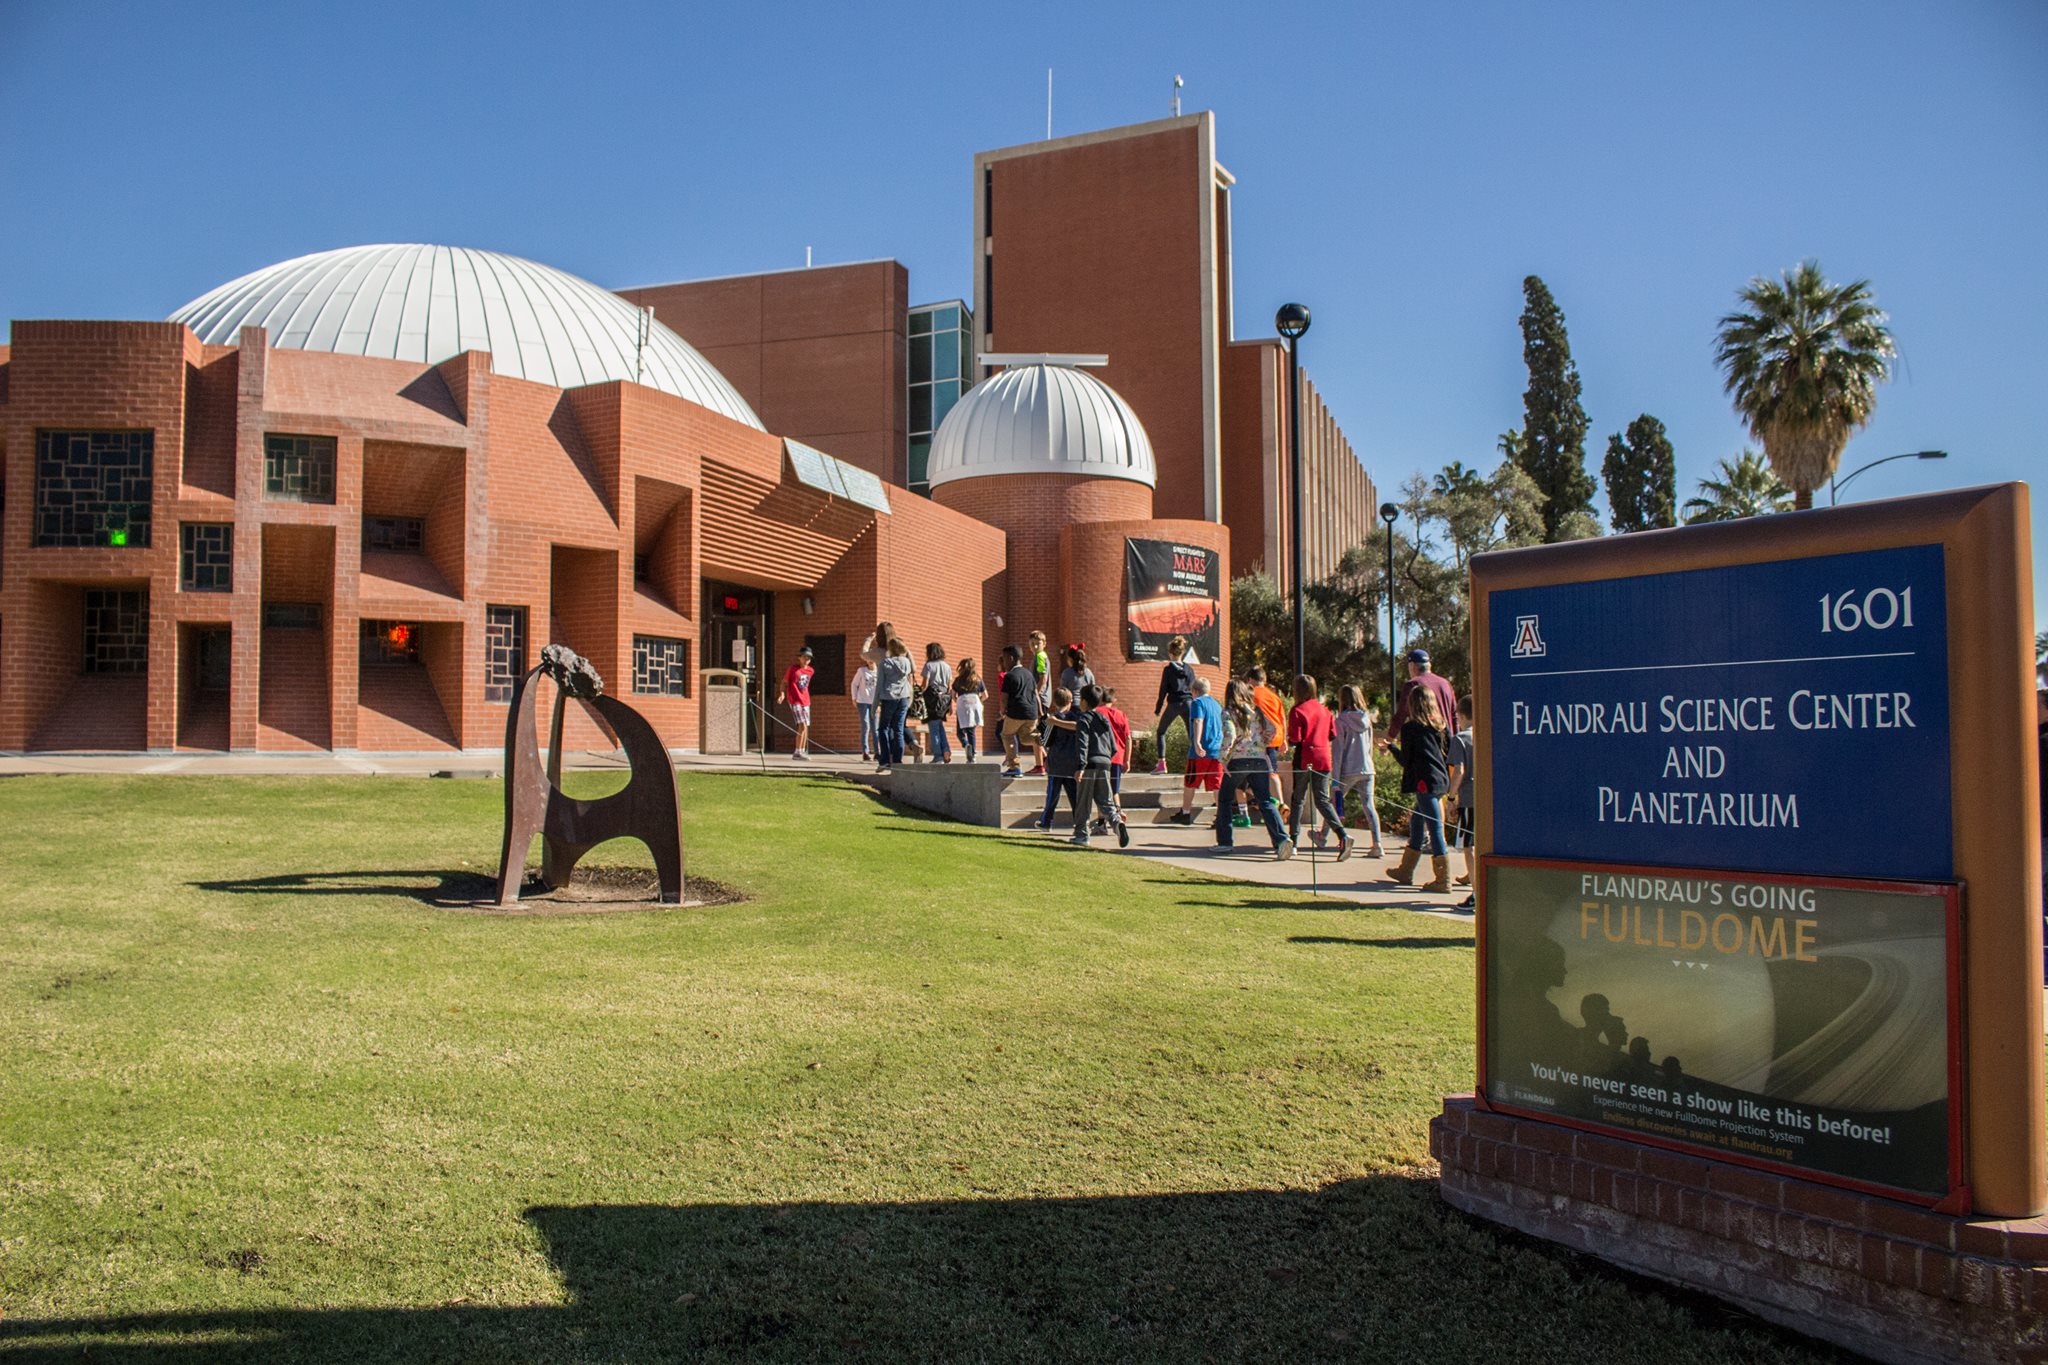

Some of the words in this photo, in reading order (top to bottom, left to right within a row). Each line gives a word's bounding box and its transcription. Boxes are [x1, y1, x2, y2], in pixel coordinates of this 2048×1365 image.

[1173, 554, 1206, 575] MARS
[1819, 586, 1914, 633] 1601
[1512, 701, 1647, 736] FLANDRAU
[1659, 695, 1776, 733] SCIENCE
[1788, 689, 1916, 731] CENTER
[1662, 746, 1726, 779] AND
[1598, 786, 1800, 828] PLANETARIUM
[1581, 874, 1723, 906] FLANDRAU'S
[1731, 884, 1817, 913] GOING
[1580, 901, 1819, 963] FULLDOME
[1514, 1091, 1555, 1106] FLANDRAU
[1530, 1062, 1578, 1086] You've
[1582, 1075, 1626, 1094] never
[1630, 1083, 1667, 1103] seen
[1672, 1091, 1682, 1106] a
[1687, 1091, 1733, 1115] show
[1737, 1099, 1771, 1122] like
[1776, 1107, 1812, 1130] this
[1818, 1113, 1891, 1145] before!
[1593, 1094, 1638, 1112] Experience
[1639, 1102, 1653, 1114] the
[1655, 1107, 1674, 1119] new
[1675, 1111, 1718, 1128] FullDome
[1719, 1119, 1767, 1137] Projection
[1769, 1128, 1804, 1145] System
[1602, 1112, 1636, 1127] Endless
[1637, 1116, 1688, 1137] discoveries
[1689, 1128, 1716, 1142] await
[1718, 1135, 1729, 1146] at
[1731, 1137, 1793, 1160] flandrau.org
